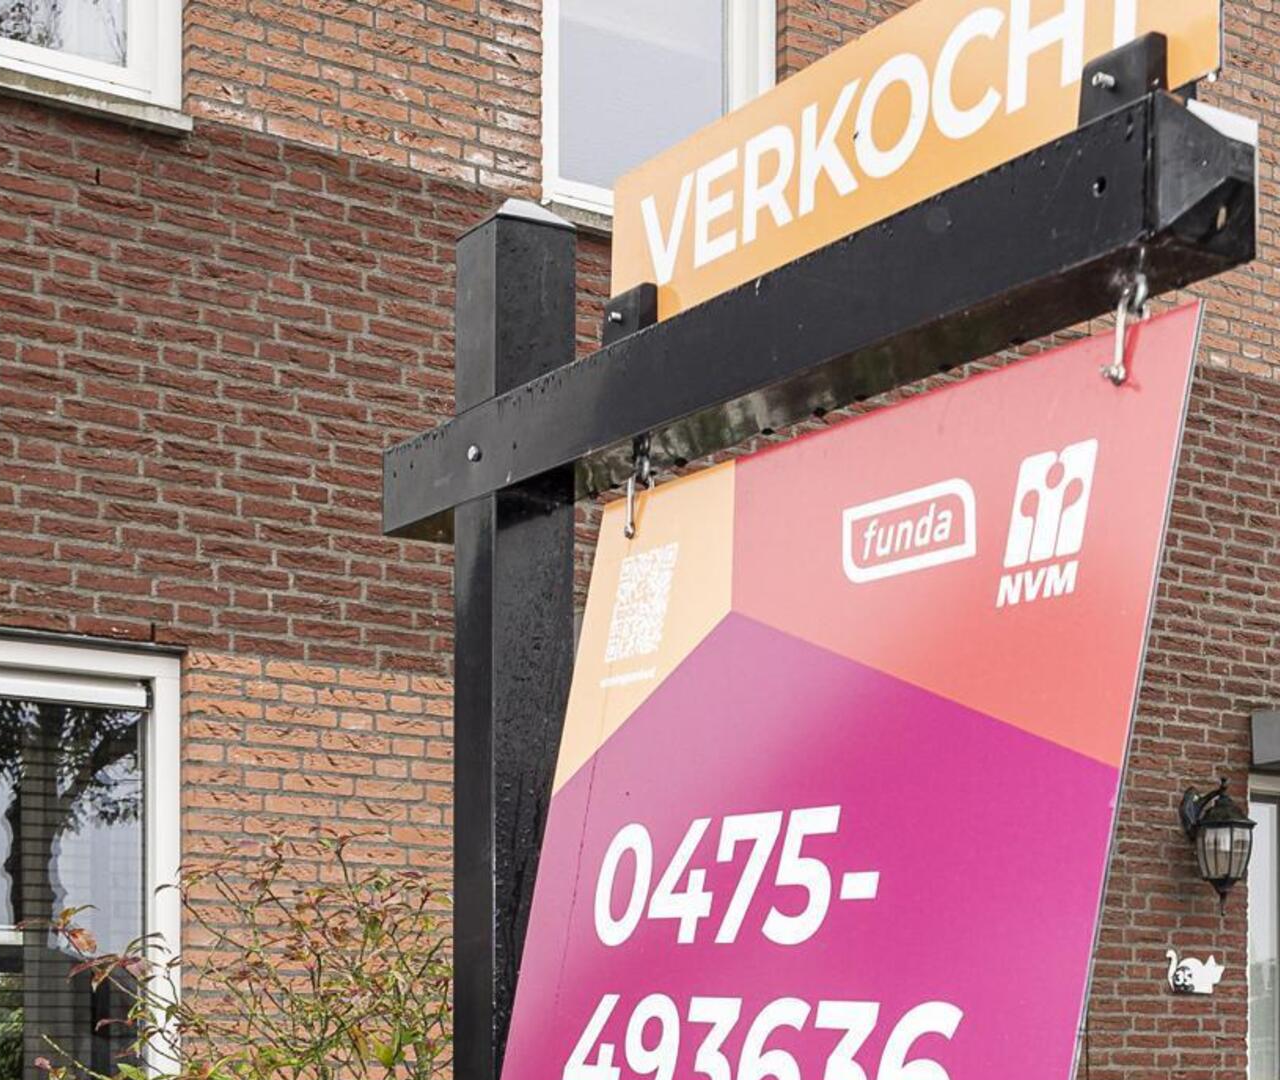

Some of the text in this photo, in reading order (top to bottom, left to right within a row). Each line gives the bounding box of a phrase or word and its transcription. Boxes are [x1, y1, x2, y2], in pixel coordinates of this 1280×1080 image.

[862, 502, 952, 560] funda
[996, 560, 1079, 608] NVM
[594, 805, 880, 946] 0475-
